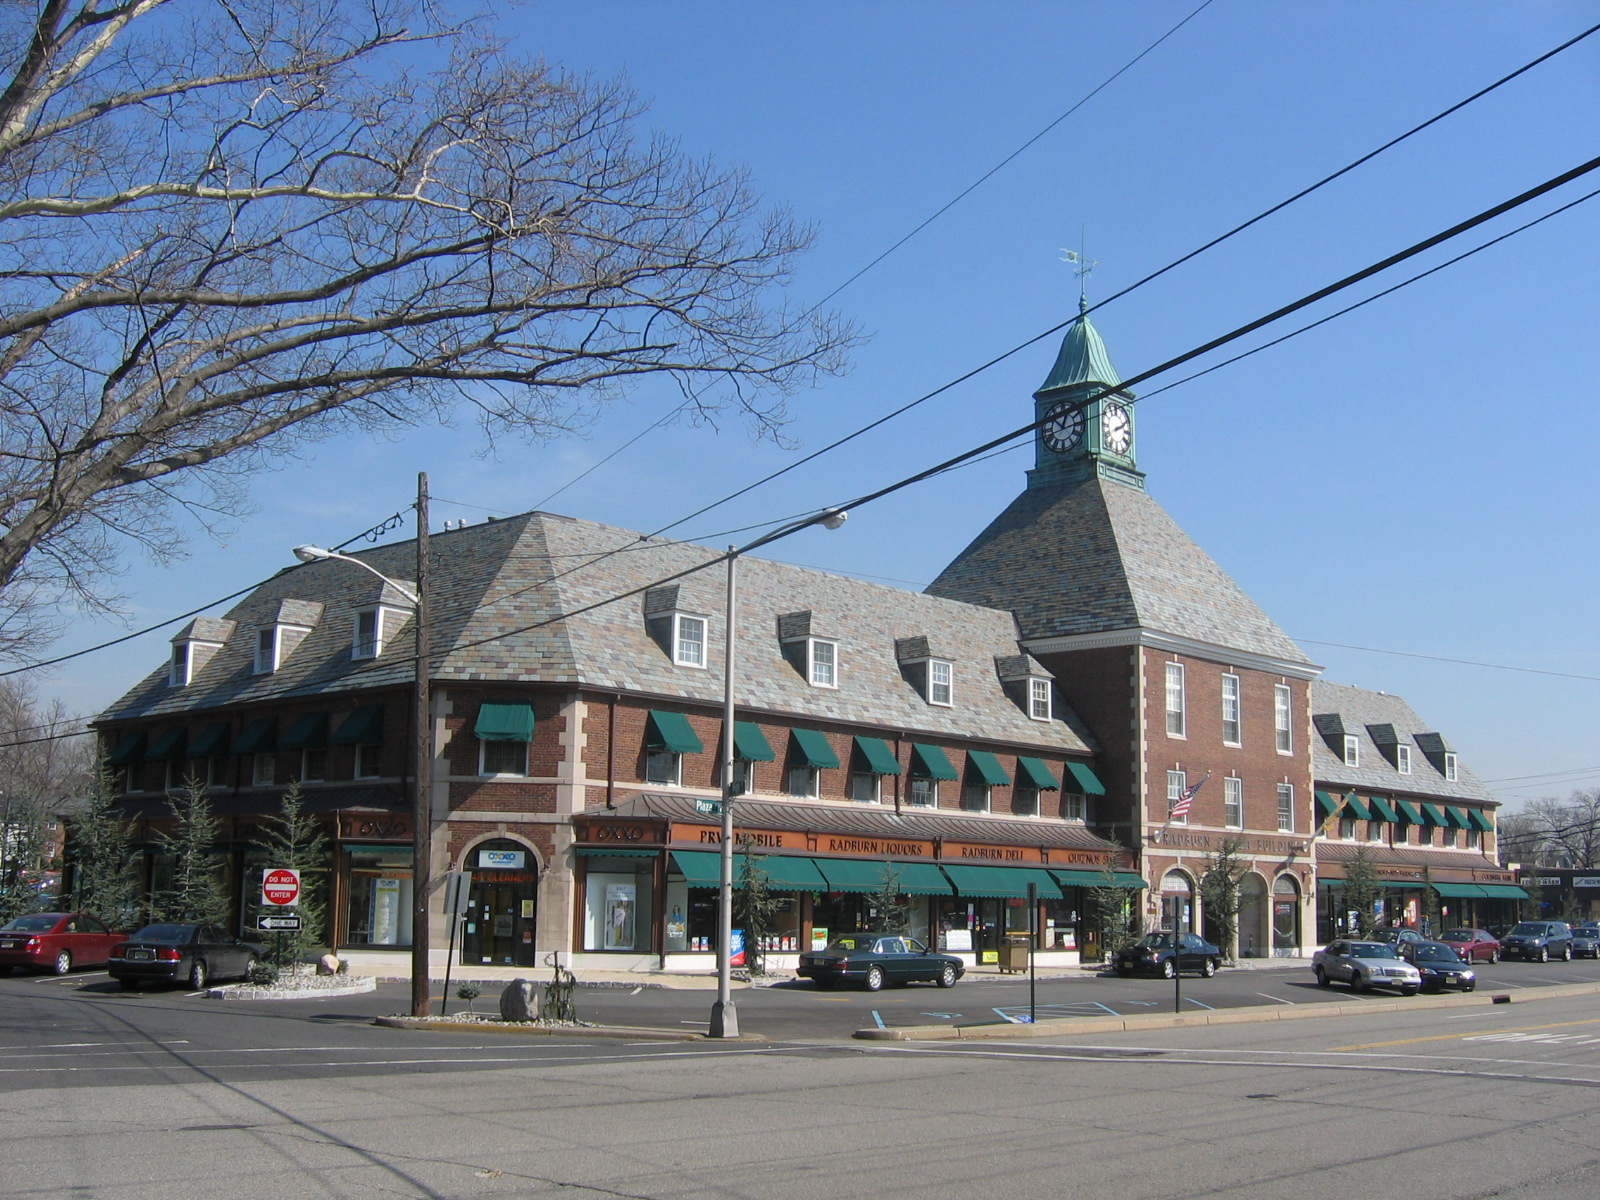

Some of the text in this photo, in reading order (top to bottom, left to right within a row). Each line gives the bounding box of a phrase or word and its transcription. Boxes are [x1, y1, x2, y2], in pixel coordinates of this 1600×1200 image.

[697, 800, 712, 812] Plaza
[597, 826, 643, 839] OXXO
[829, 838, 922, 856] RADBURN LIQUORS
[1163, 833, 1210, 848] RADBURN
[488, 852, 516, 861] OXXO
[962, 847, 1023, 861] RADBURN DELI
[1068, 853, 1100, 865] QUIZNOS
